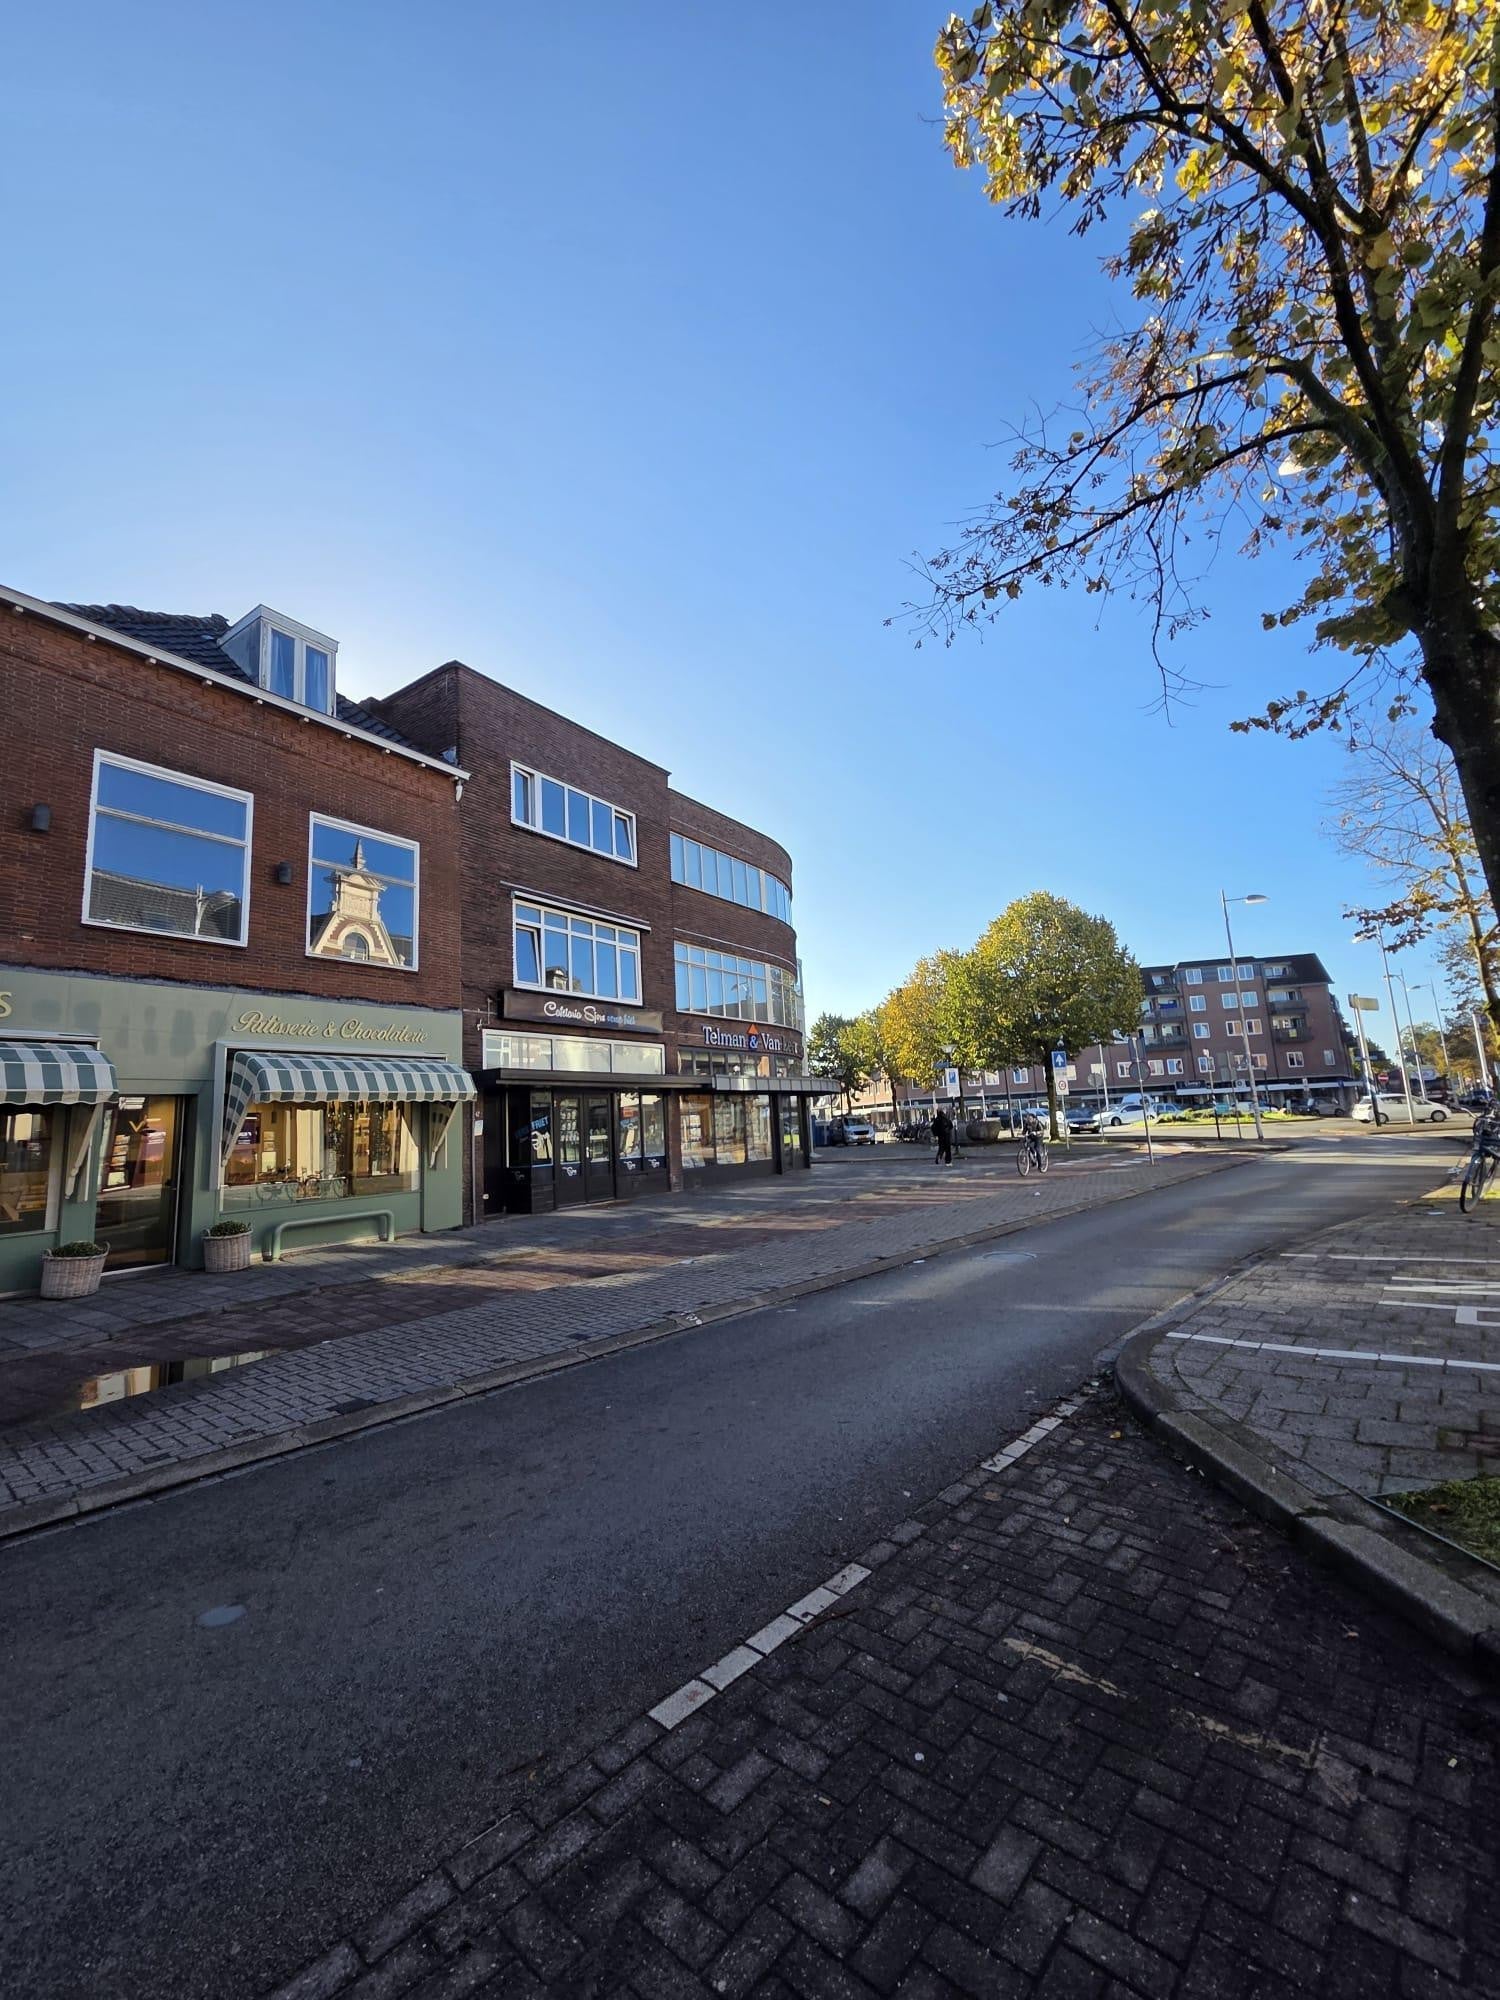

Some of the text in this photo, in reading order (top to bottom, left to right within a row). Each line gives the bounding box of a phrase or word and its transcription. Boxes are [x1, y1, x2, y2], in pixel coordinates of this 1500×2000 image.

[322, 1020, 336, 1039] &
[340, 1018, 428, 1044] Chocolaterie
[702, 1025, 747, 1048] Telman
[749, 1035, 759, 1049] &
